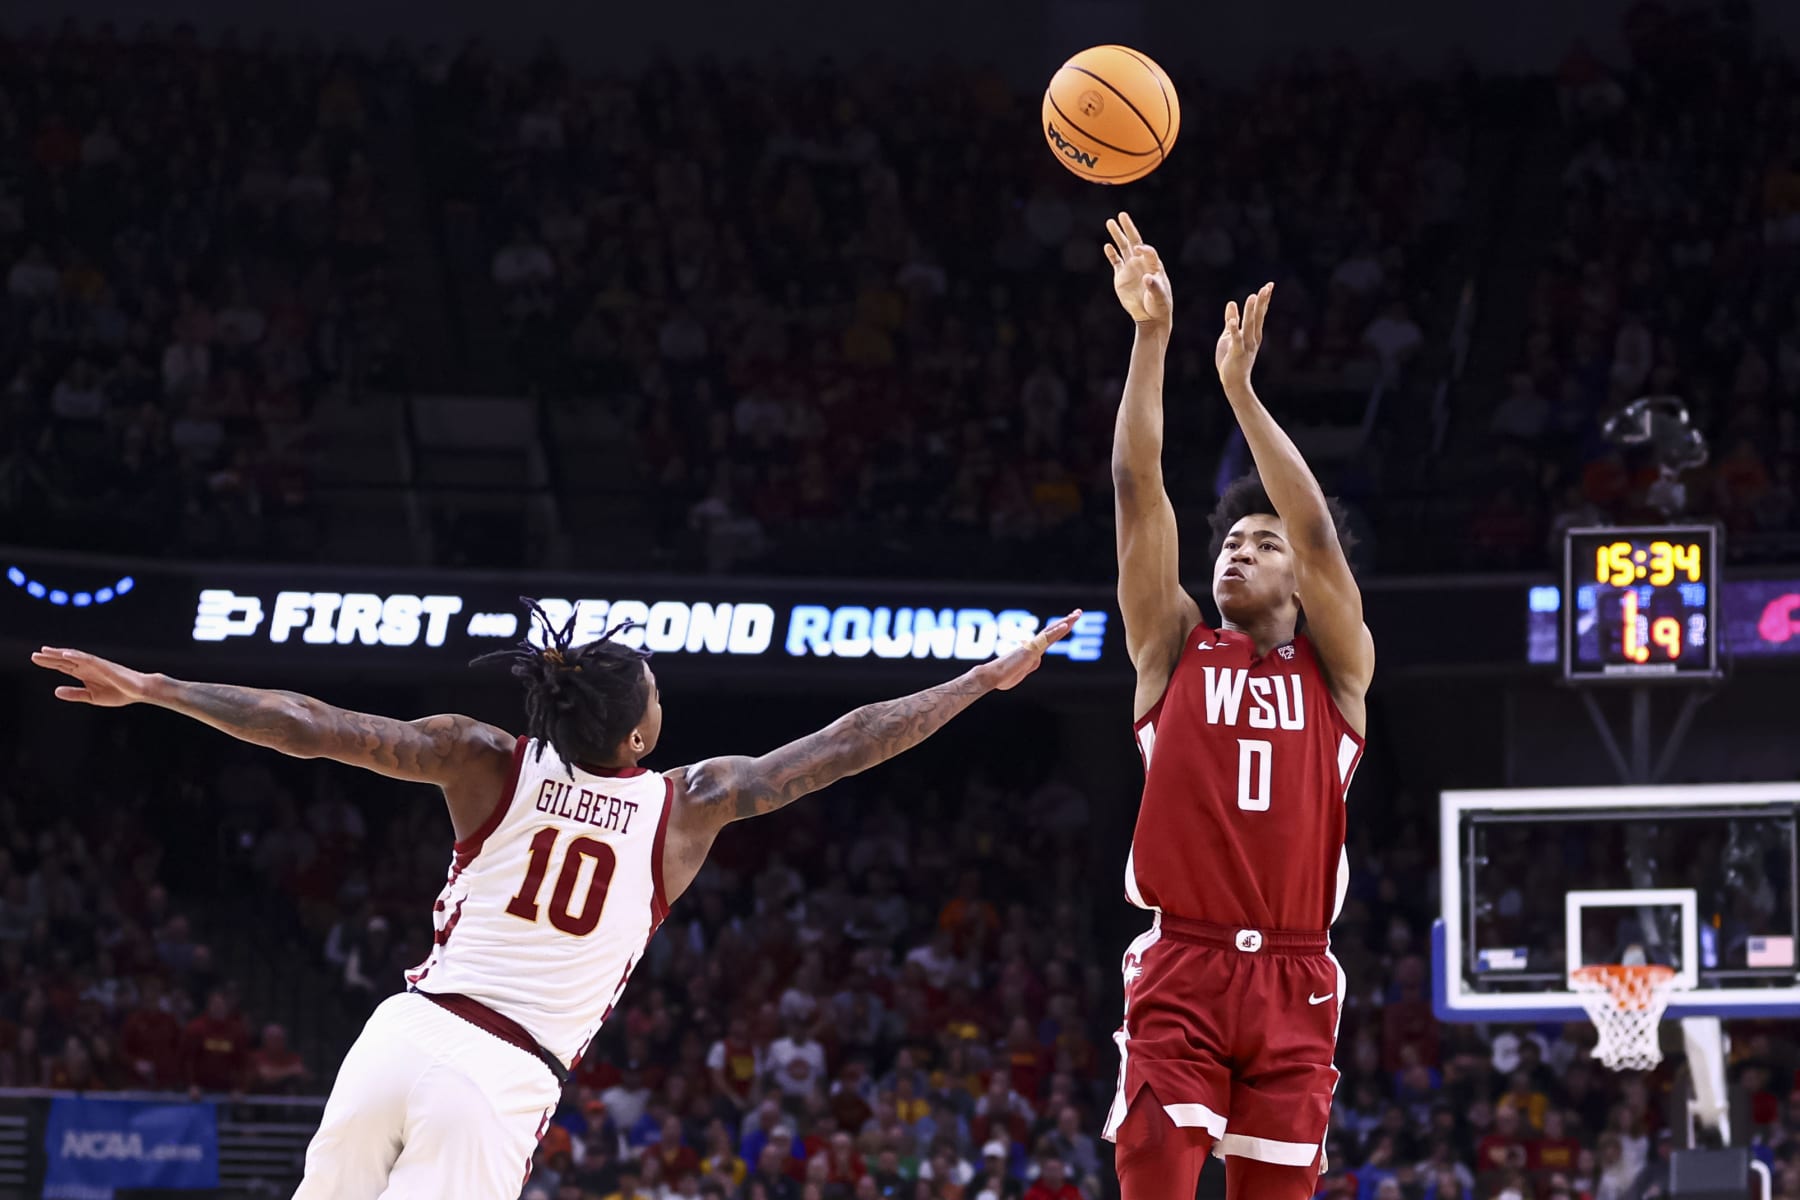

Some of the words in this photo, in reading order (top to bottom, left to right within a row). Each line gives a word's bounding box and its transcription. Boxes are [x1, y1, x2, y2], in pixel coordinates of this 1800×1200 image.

[1049, 122, 1098, 168] NCAA
[1597, 541, 1701, 587] 15:34
[269, 592, 463, 647] FIRST
[527, 598, 775, 654] SECOND
[785, 605, 1040, 660] ROUNDS
[1202, 667, 1305, 730] WSU
[536, 778, 639, 834] GILBERT
[1237, 738, 1273, 812] 0
[505, 826, 616, 937] 10
